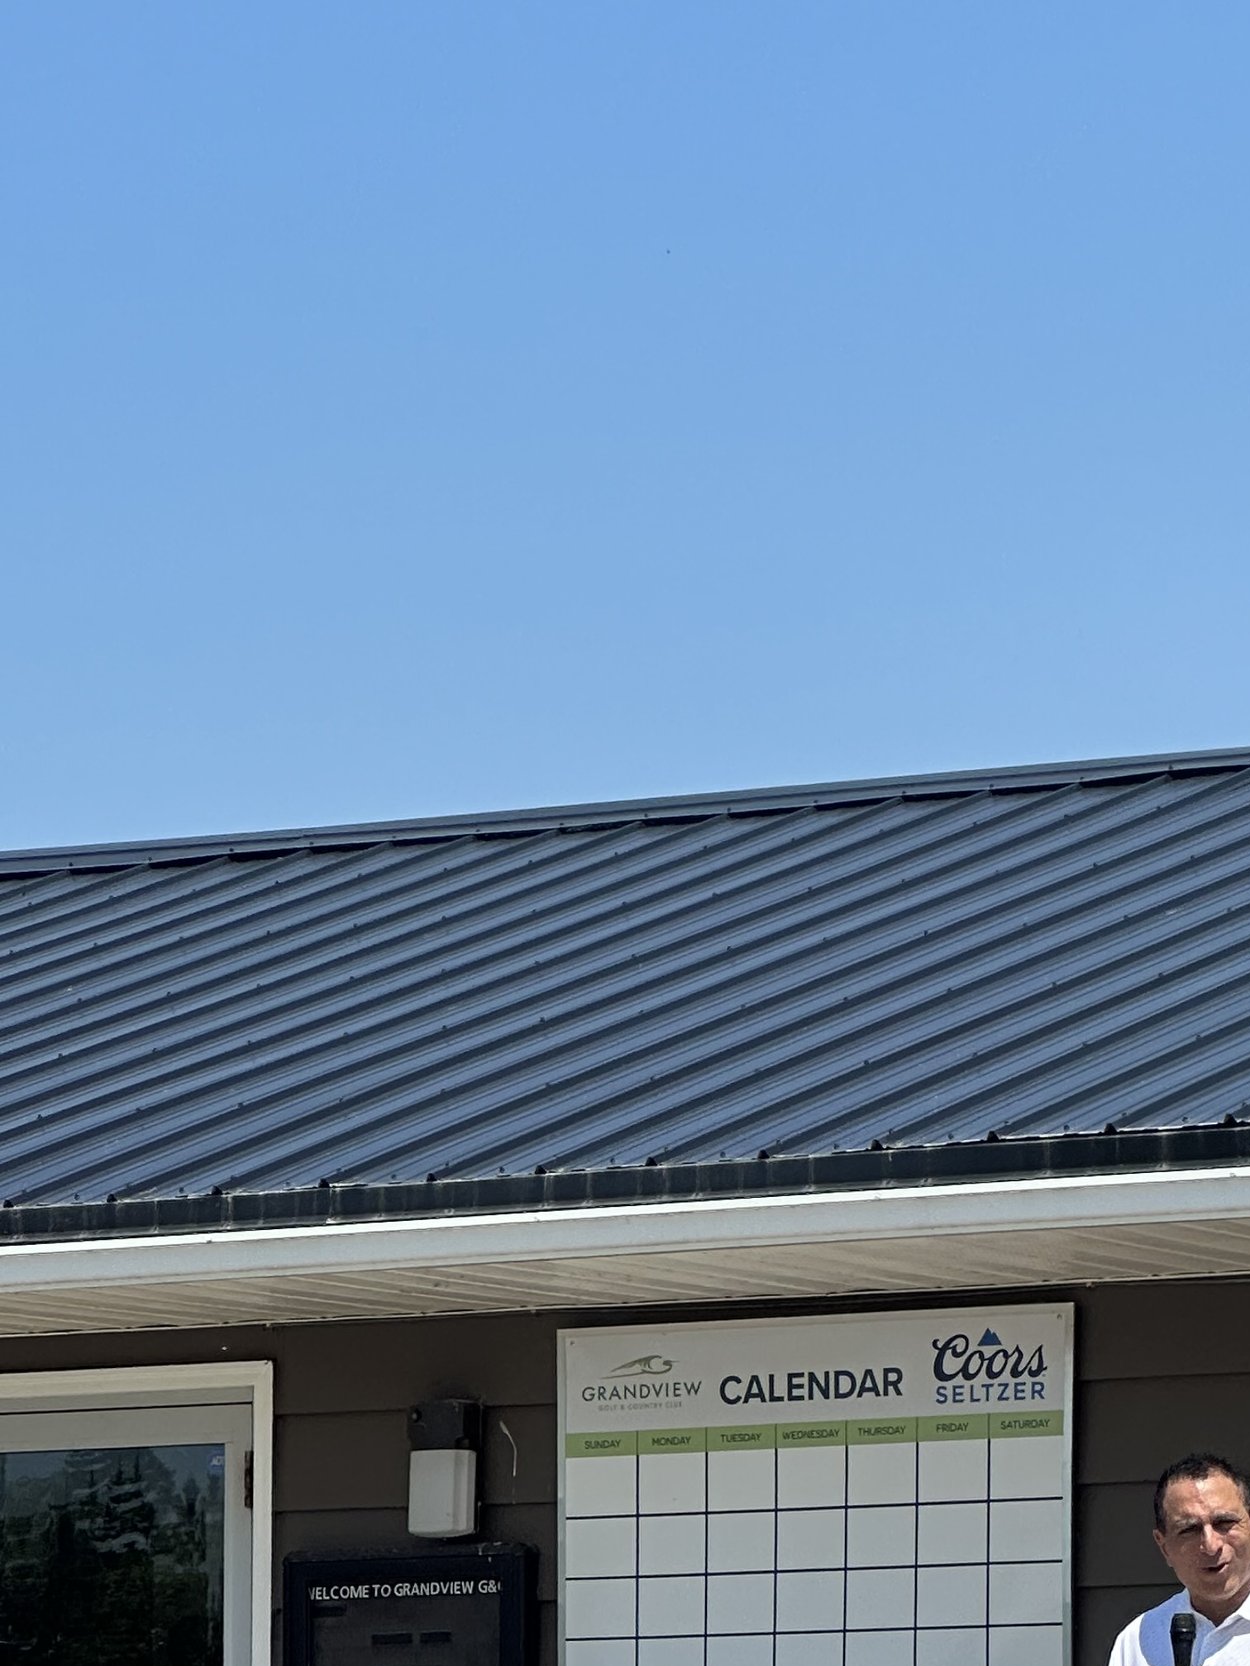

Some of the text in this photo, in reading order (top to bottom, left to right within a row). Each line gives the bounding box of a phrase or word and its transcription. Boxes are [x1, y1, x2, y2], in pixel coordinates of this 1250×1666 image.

[932, 1334, 1047, 1382] Coors
[582, 1380, 702, 1402] GRANDVIEW
[719, 1367, 903, 1405] CALENDAR
[936, 1381, 1045, 1404] SELTZER
[584, 1419, 1050, 1450] SUNDAY MONDAY TUESDAY WEDNESDAY THURSDAY FRIDAY SATURDAY
[372, 1584, 391, 1598] TO
[394, 1581, 474, 1597] GRANDVIEW
